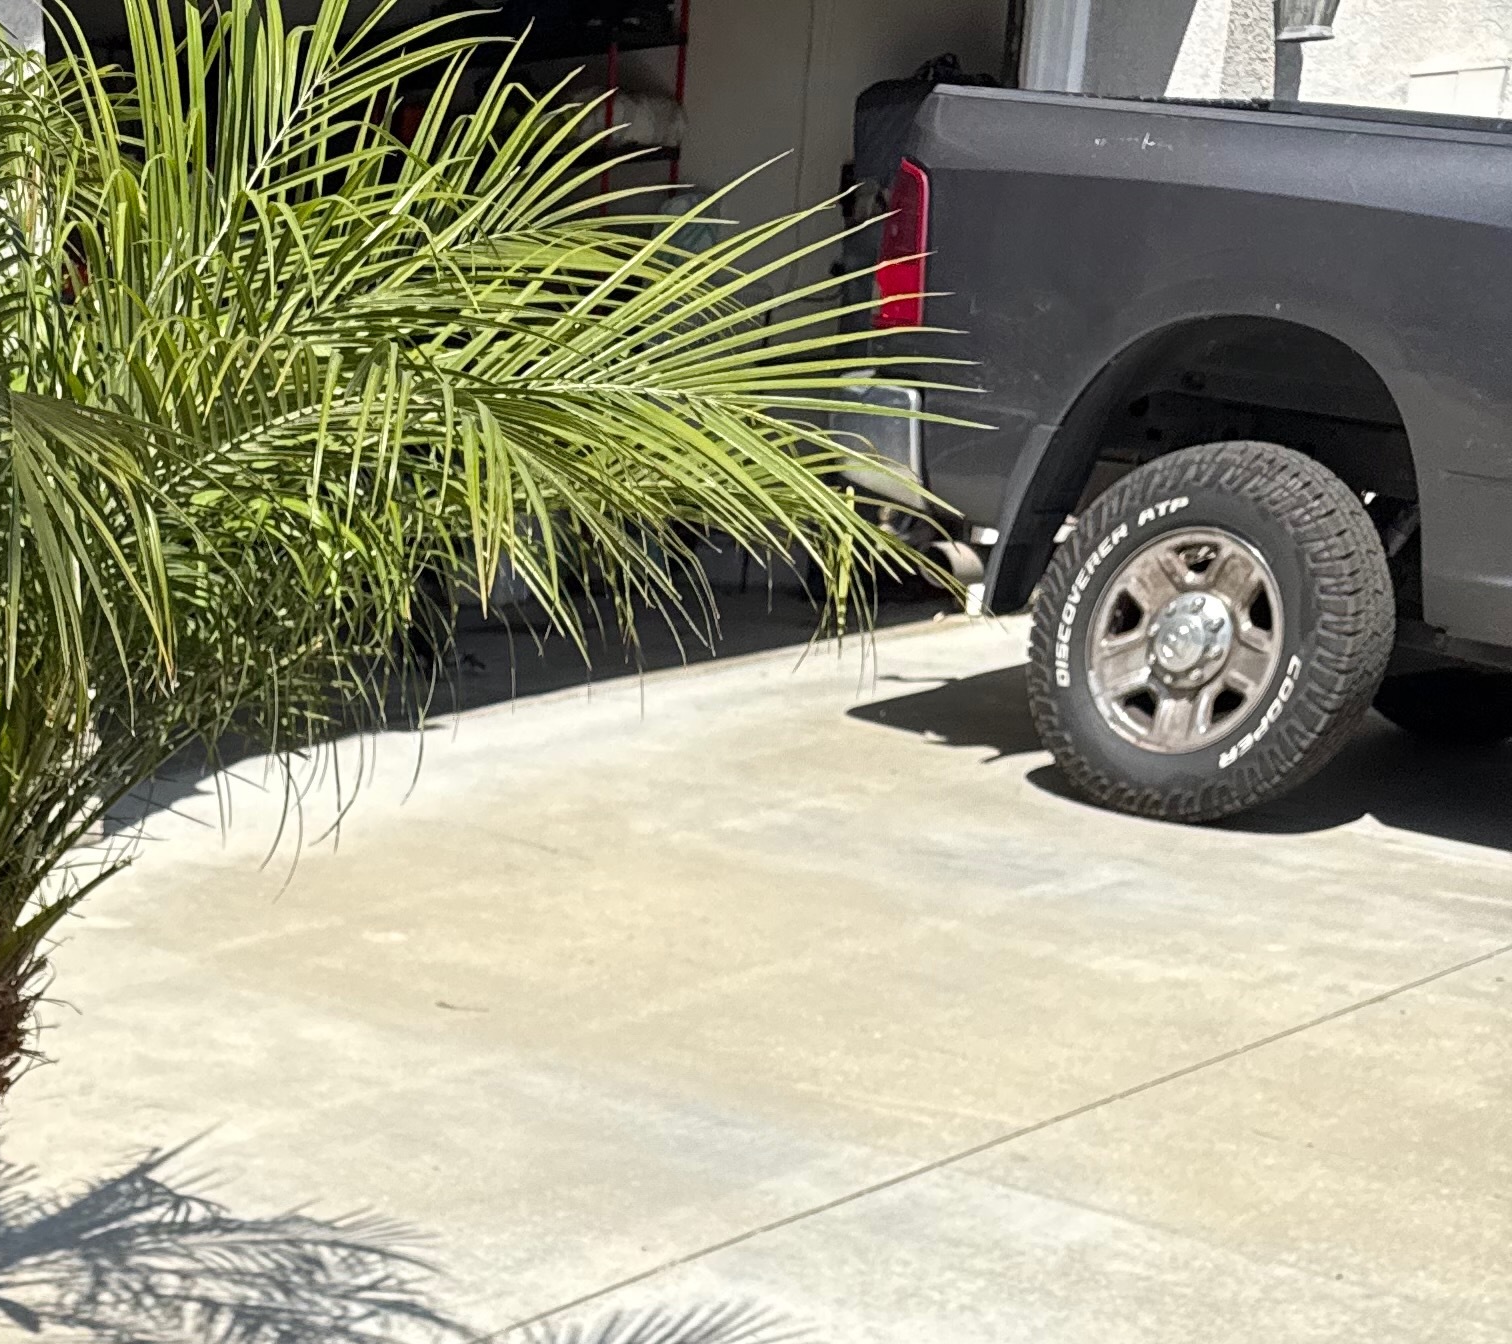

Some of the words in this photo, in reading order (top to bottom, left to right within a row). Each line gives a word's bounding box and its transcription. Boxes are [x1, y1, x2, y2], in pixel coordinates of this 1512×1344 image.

[1054, 522, 1129, 688] DISCOVERER
[1138, 496, 1189, 527] ATP
[1218, 654, 1302, 769] COOPER
